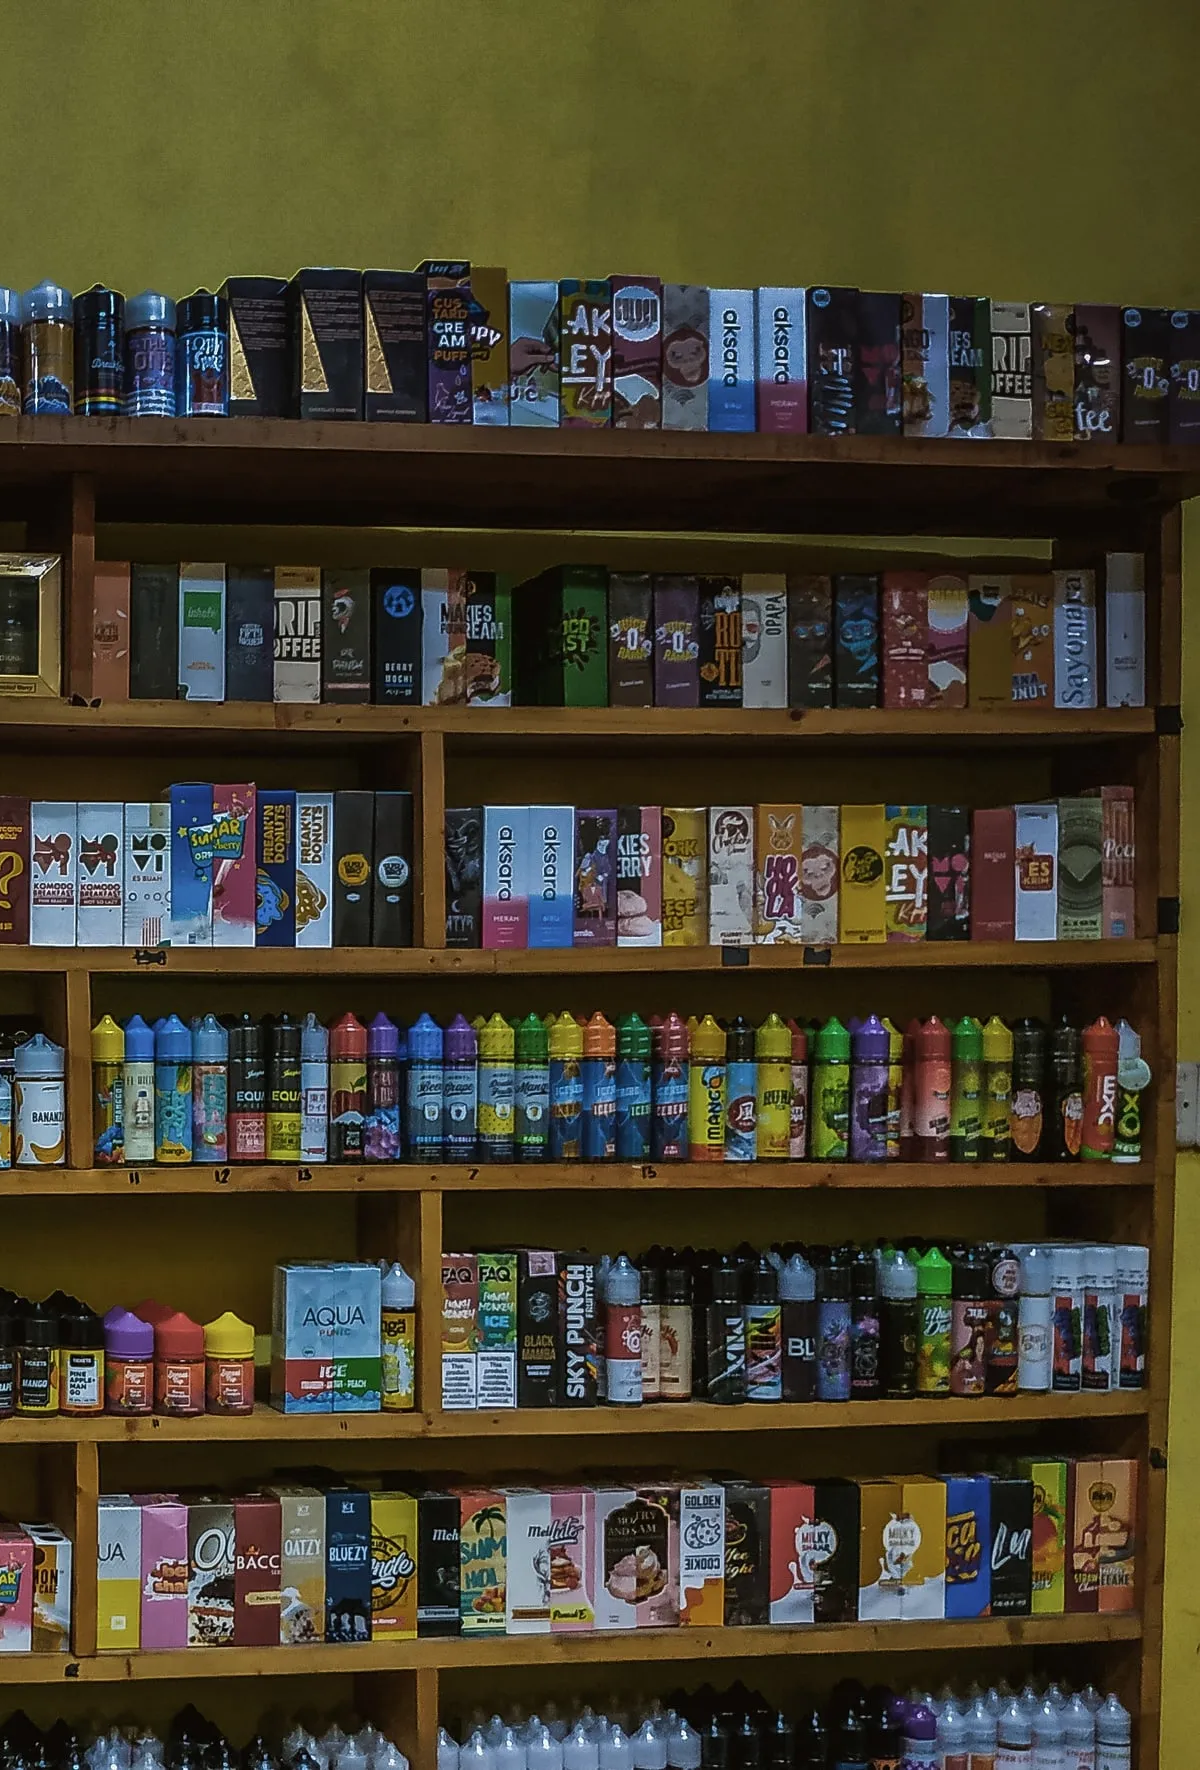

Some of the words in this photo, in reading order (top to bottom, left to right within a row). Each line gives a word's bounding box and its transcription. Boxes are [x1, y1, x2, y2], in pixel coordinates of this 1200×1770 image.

[433, 298, 461, 309] CUS
[433, 309, 468, 319] TARD
[433, 322, 463, 333] CRE
[438, 335, 465, 347] AM
[722, 309, 738, 387] aksara
[773, 306, 789, 384] aksara
[434, 351, 468, 361] PUFF
[764, 593, 785, 636] OPAPA
[1062, 576, 1086, 705] Sayonara
[385, 663, 413, 673] BERRY
[385, 674, 413, 683] MOCHI
[263, 805, 273, 864] FREAK'N
[274, 804, 285, 864] DONUTS
[301, 806, 311, 864] FREAK'N
[312, 805, 322, 864] DONUTS
[499, 826, 514, 901] aksara
[543, 826, 558, 901] aksara
[1029, 862, 1049, 877] ES
[81, 883, 120, 891] KOMODO
[215, 1169, 231, 1183] 12
[441, 1266, 472, 1283] FAQ
[479, 1266, 512, 1283] FAQ
[585, 1265, 594, 1282] MIX
[566, 1265, 585, 1345] PUNCH
[585, 1282, 594, 1319] FRUITY
[303, 1306, 365, 1328] AQUA
[485, 1316, 509, 1328] ICE
[525, 1335, 554, 1347] BLACK
[522, 1347, 556, 1360] MAMBA
[24, 1360, 47, 1368] TICKETS
[319, 1364, 348, 1377] ICE
[566, 1351, 586, 1399] SKY
[22, 1378, 48, 1389] MANGO
[685, 1495, 721, 1506] GOLDEN
[801, 1529, 829, 1545] MILKY
[888, 1528, 916, 1540] MILKY
[284, 1538, 321, 1556] OATZY
[329, 1546, 368, 1562] BLUEZY
[236, 1555, 280, 1570] BACC
[684, 1558, 720, 1570] COOKIE
